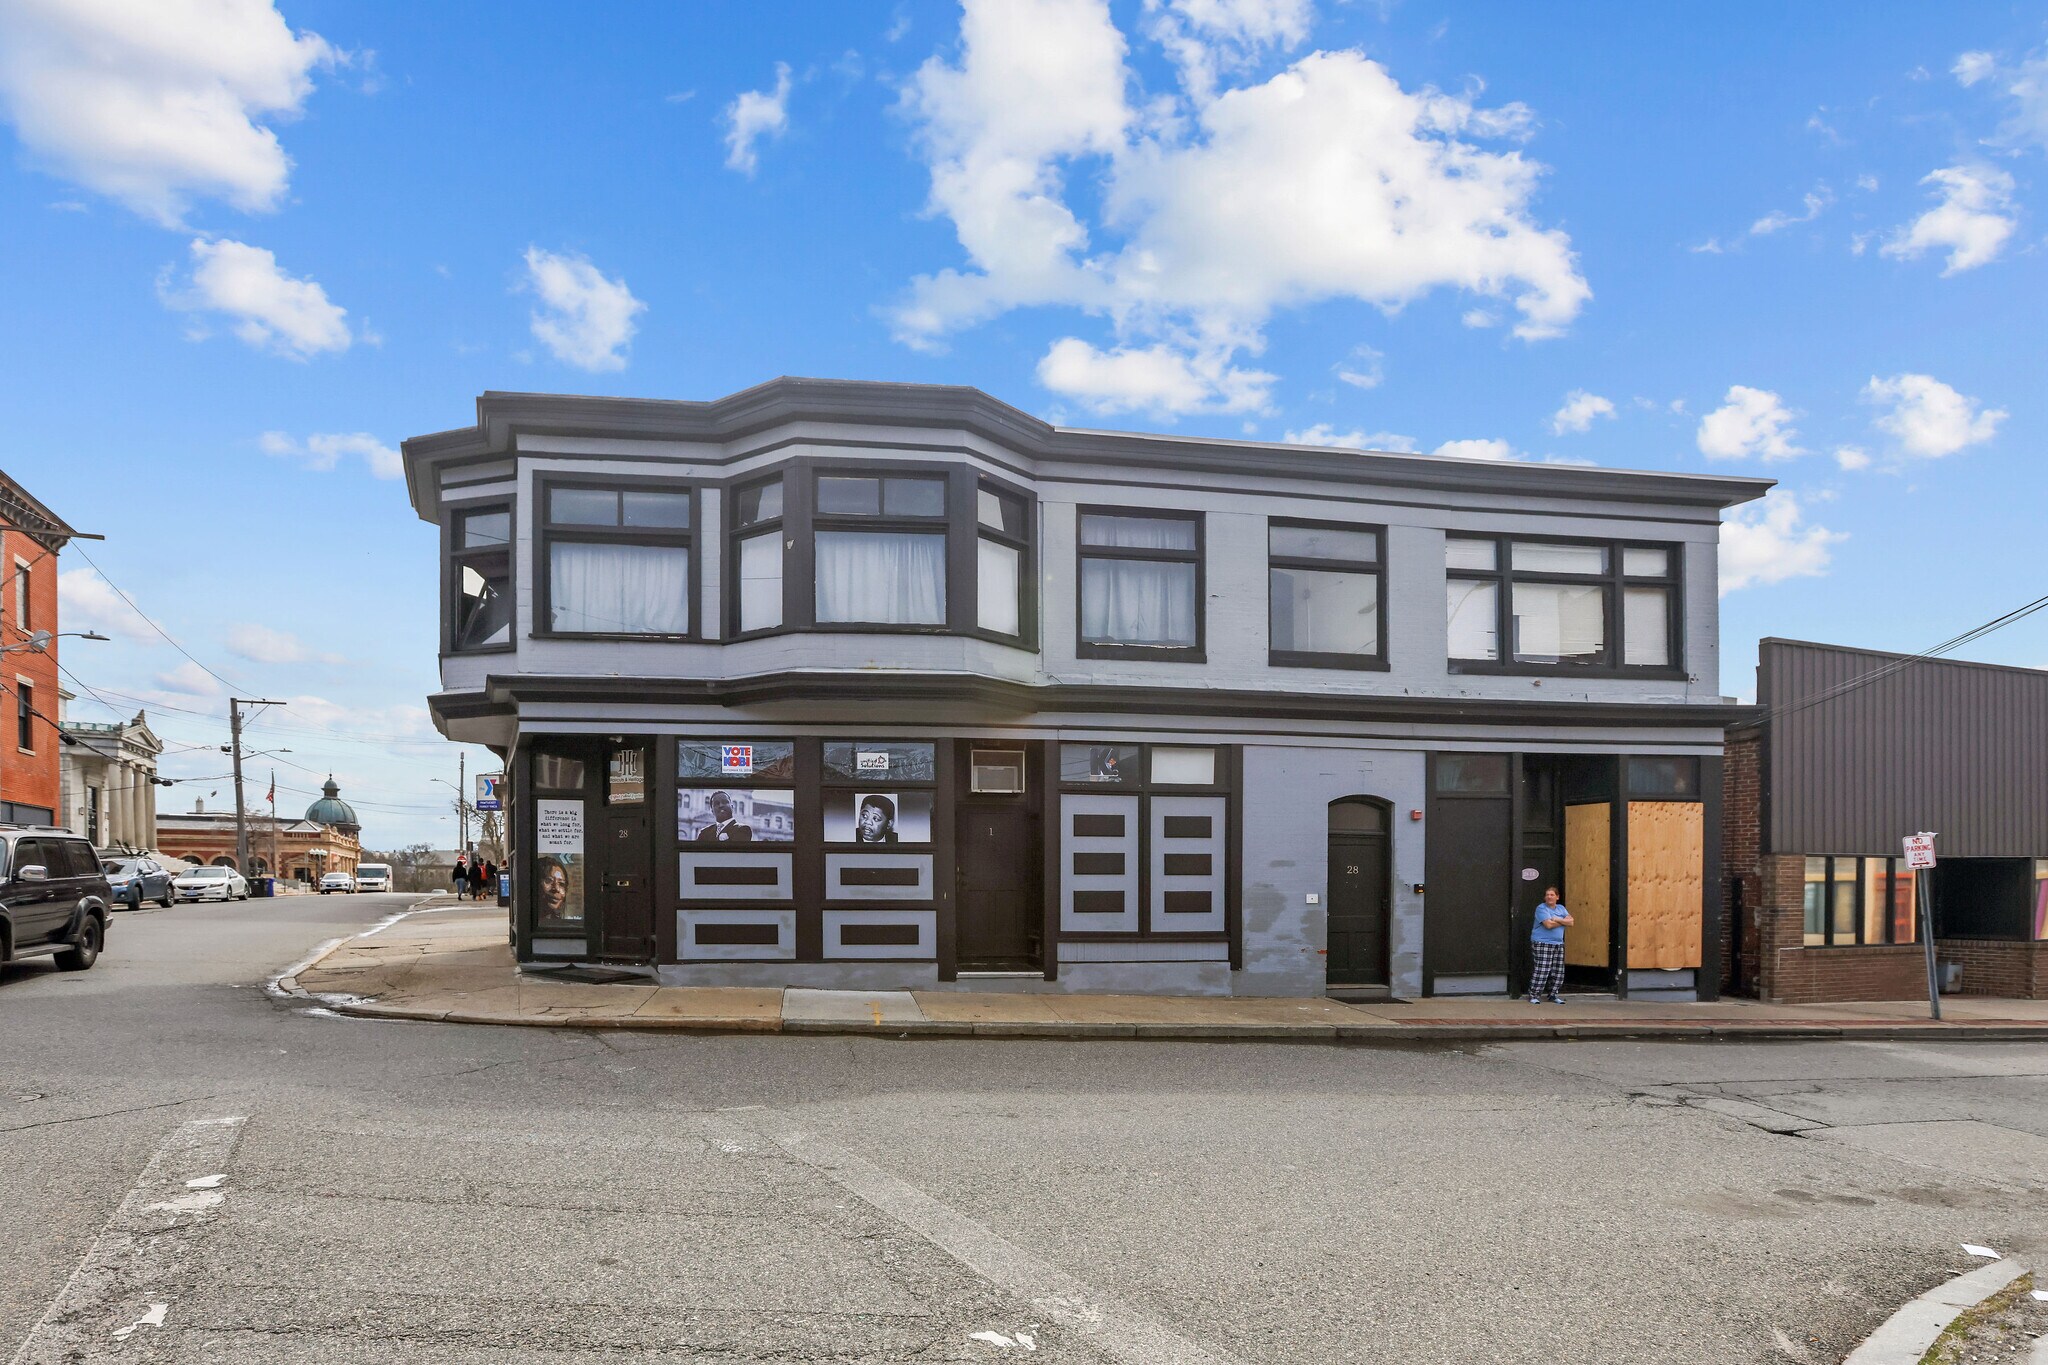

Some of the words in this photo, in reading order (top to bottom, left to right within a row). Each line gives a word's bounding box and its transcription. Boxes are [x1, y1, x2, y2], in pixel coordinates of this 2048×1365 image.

[723, 747, 750, 756] VOTE
[724, 757, 750, 766] KOBI
[619, 830, 628, 838] 28
[1346, 866, 1358, 874] 28
